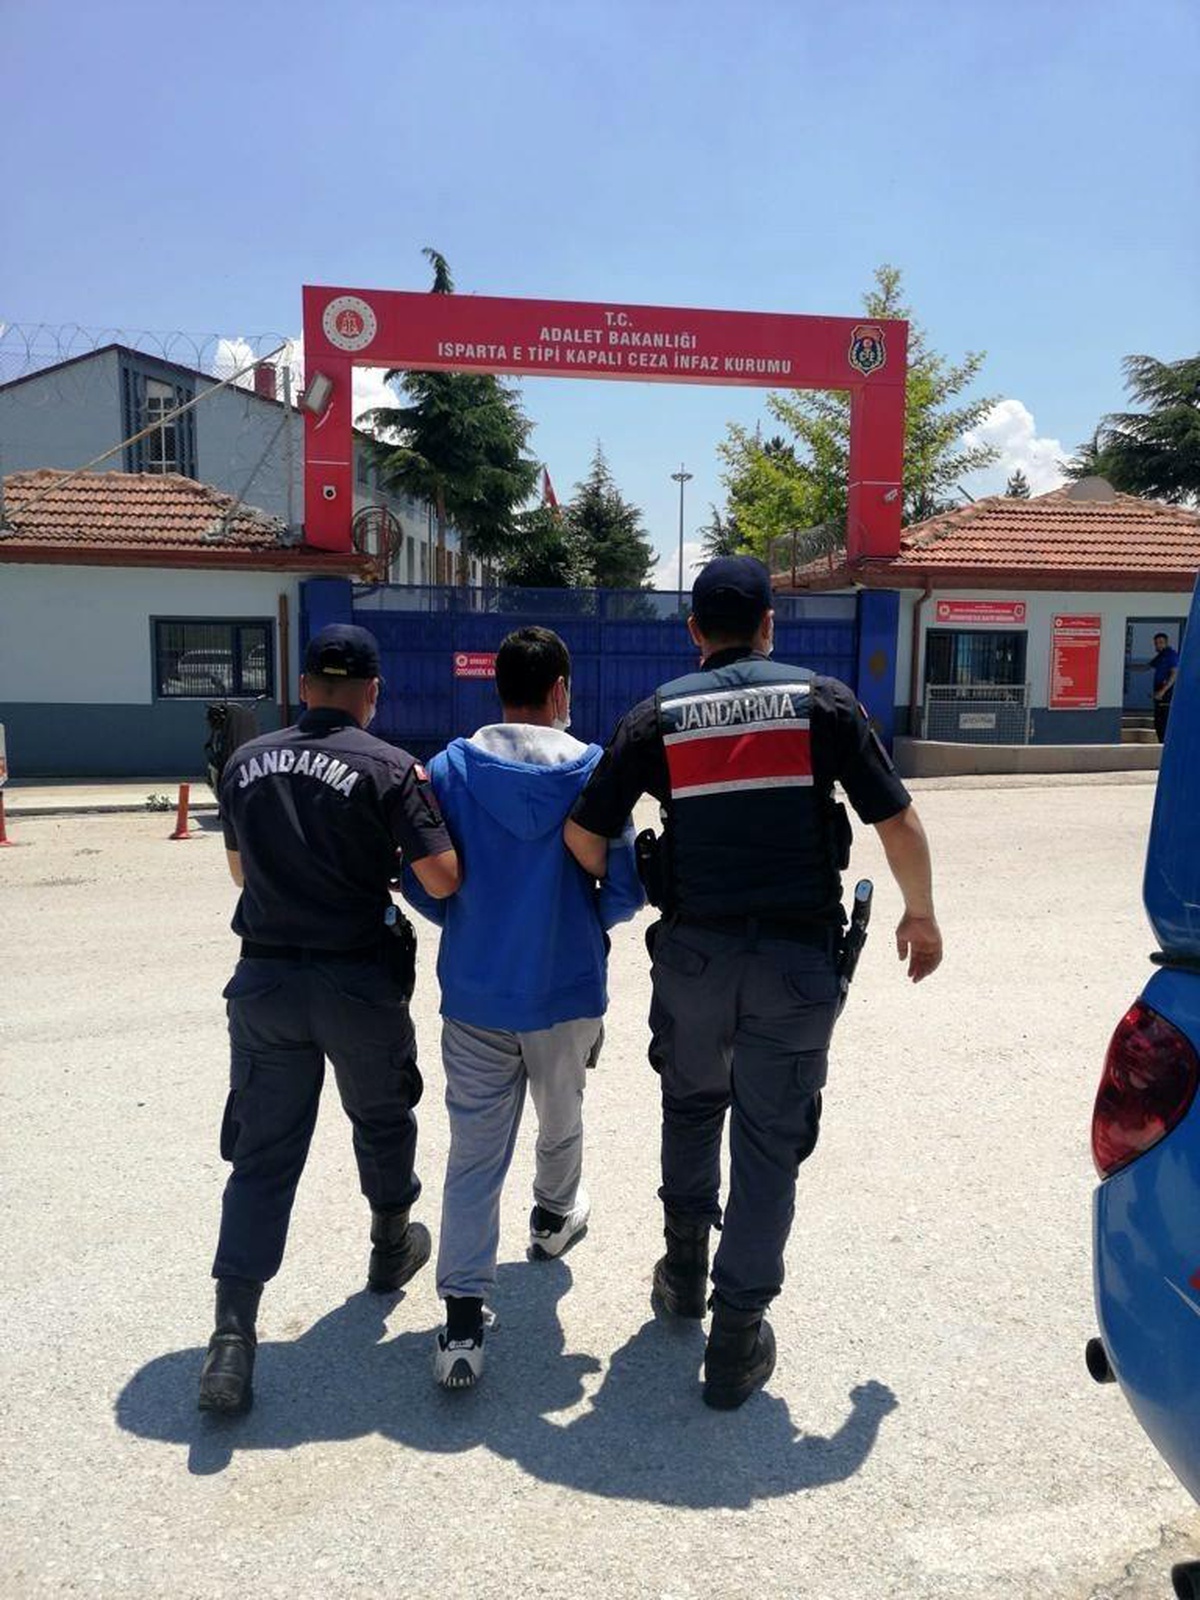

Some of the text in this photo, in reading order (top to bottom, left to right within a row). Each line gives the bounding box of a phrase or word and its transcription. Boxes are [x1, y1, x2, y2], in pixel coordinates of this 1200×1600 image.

[605, 312, 633, 327] T.C.
[539, 327, 697, 349] ADALET BAKANLIĞI
[438, 342, 792, 374] ISPARTA E TİPİ KAPALI CEZA İNFAZ KURUMU
[675, 693, 797, 732] JANDARMA
[237, 749, 362, 798] JANDARMA
